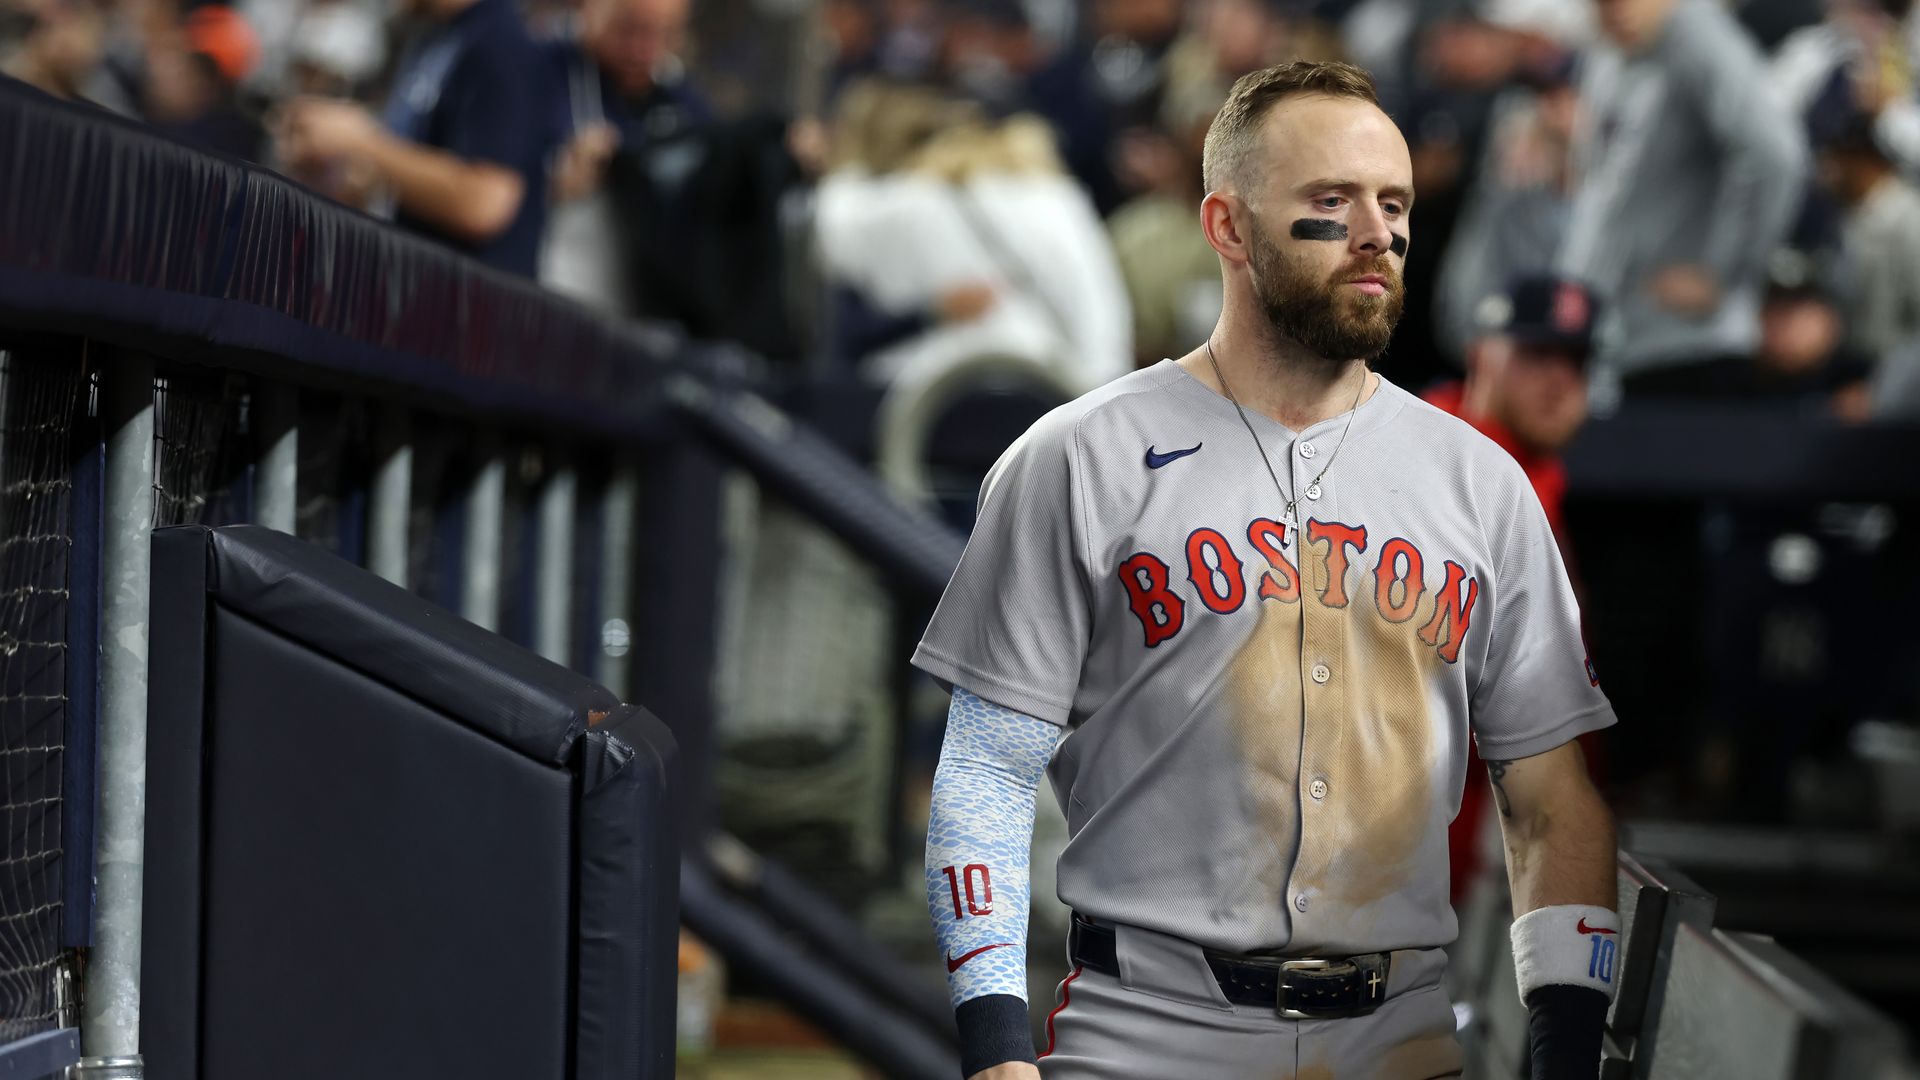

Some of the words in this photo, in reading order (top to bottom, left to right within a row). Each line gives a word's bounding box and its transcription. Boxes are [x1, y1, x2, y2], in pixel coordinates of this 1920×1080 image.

[1118, 515, 1479, 664] BOSTON
[942, 863, 993, 920] 10
[1588, 934, 1616, 984] 10
